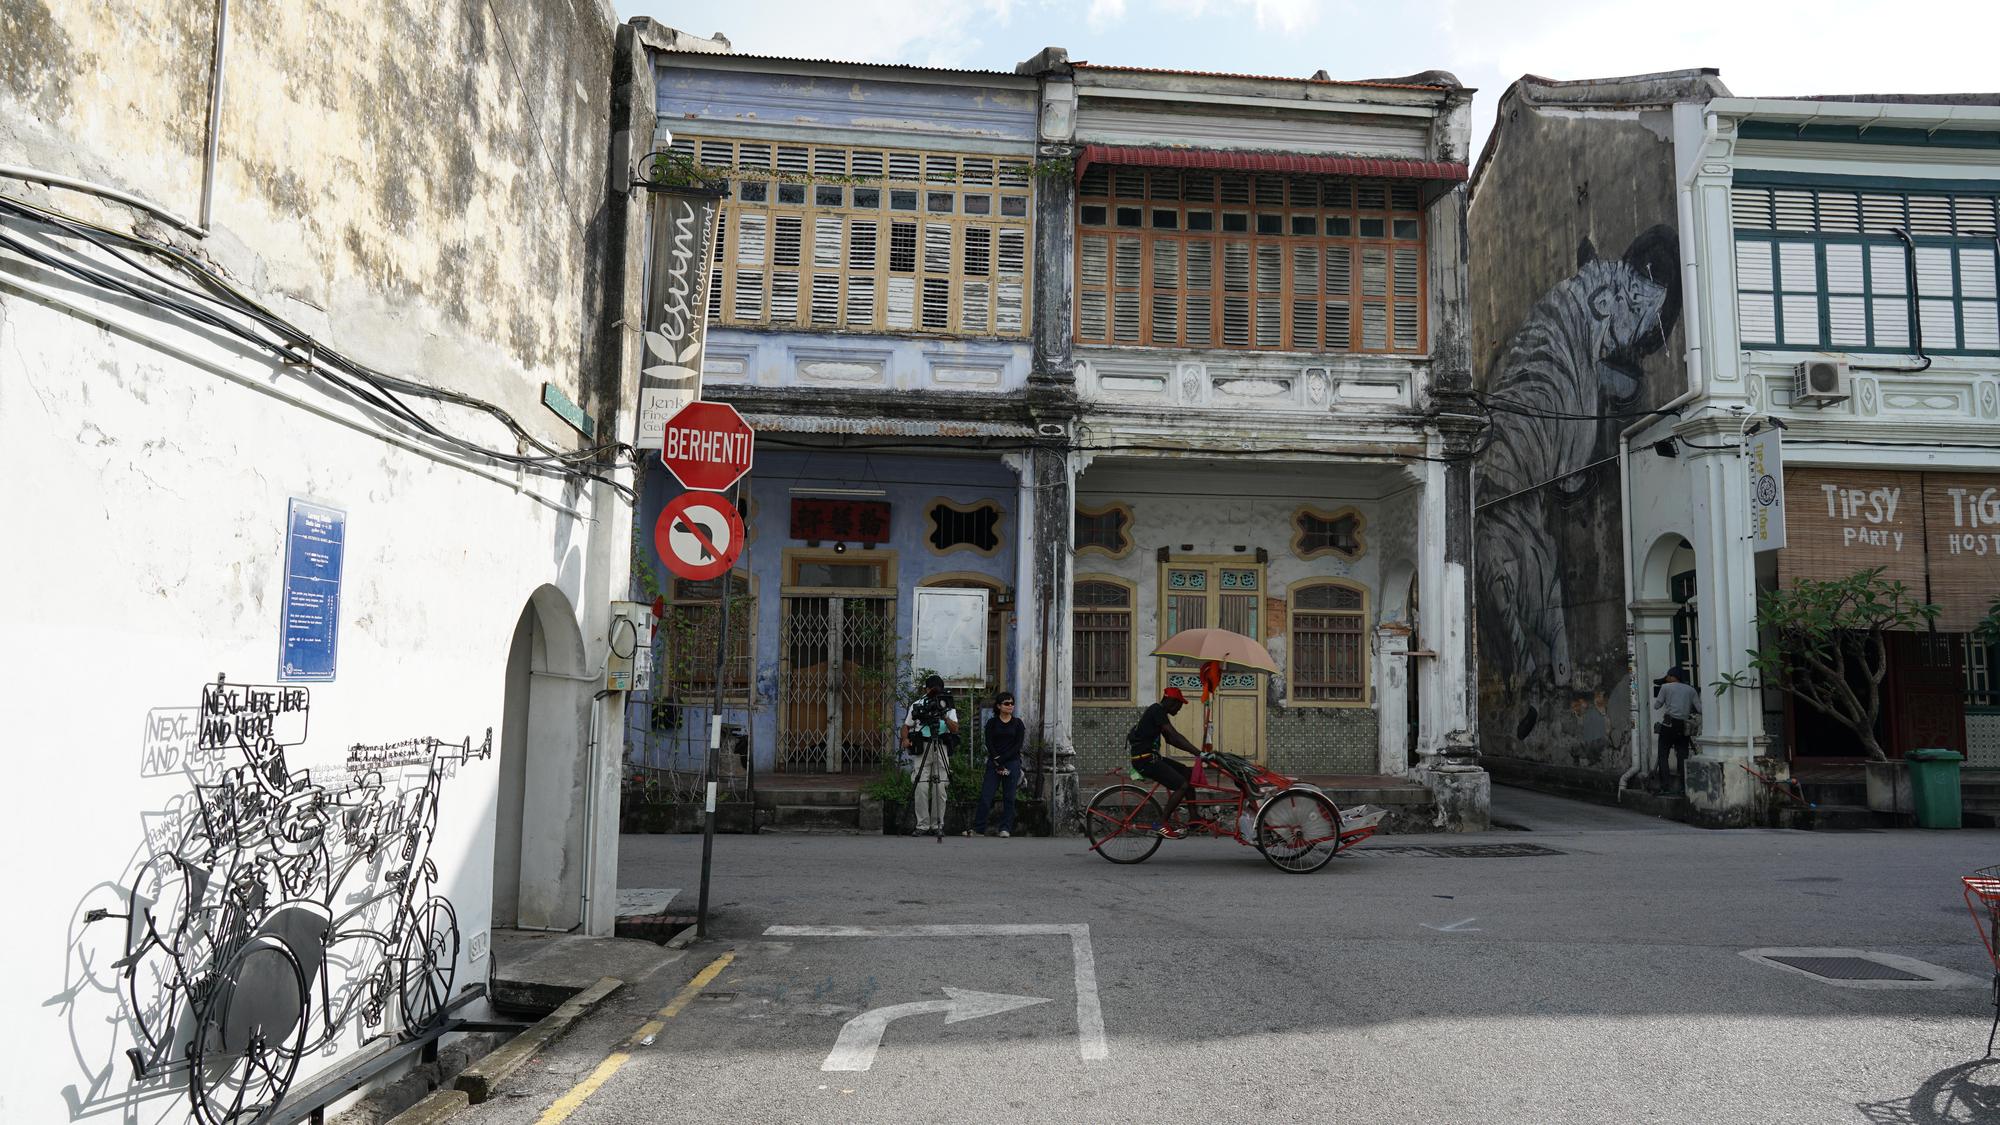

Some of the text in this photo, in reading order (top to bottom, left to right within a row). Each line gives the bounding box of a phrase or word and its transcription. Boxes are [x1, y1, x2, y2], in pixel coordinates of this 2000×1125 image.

[688, 202, 715, 343] Art Restaurant
[667, 427, 749, 465] BERHENTI
[1844, 527, 1903, 551] PARTY
